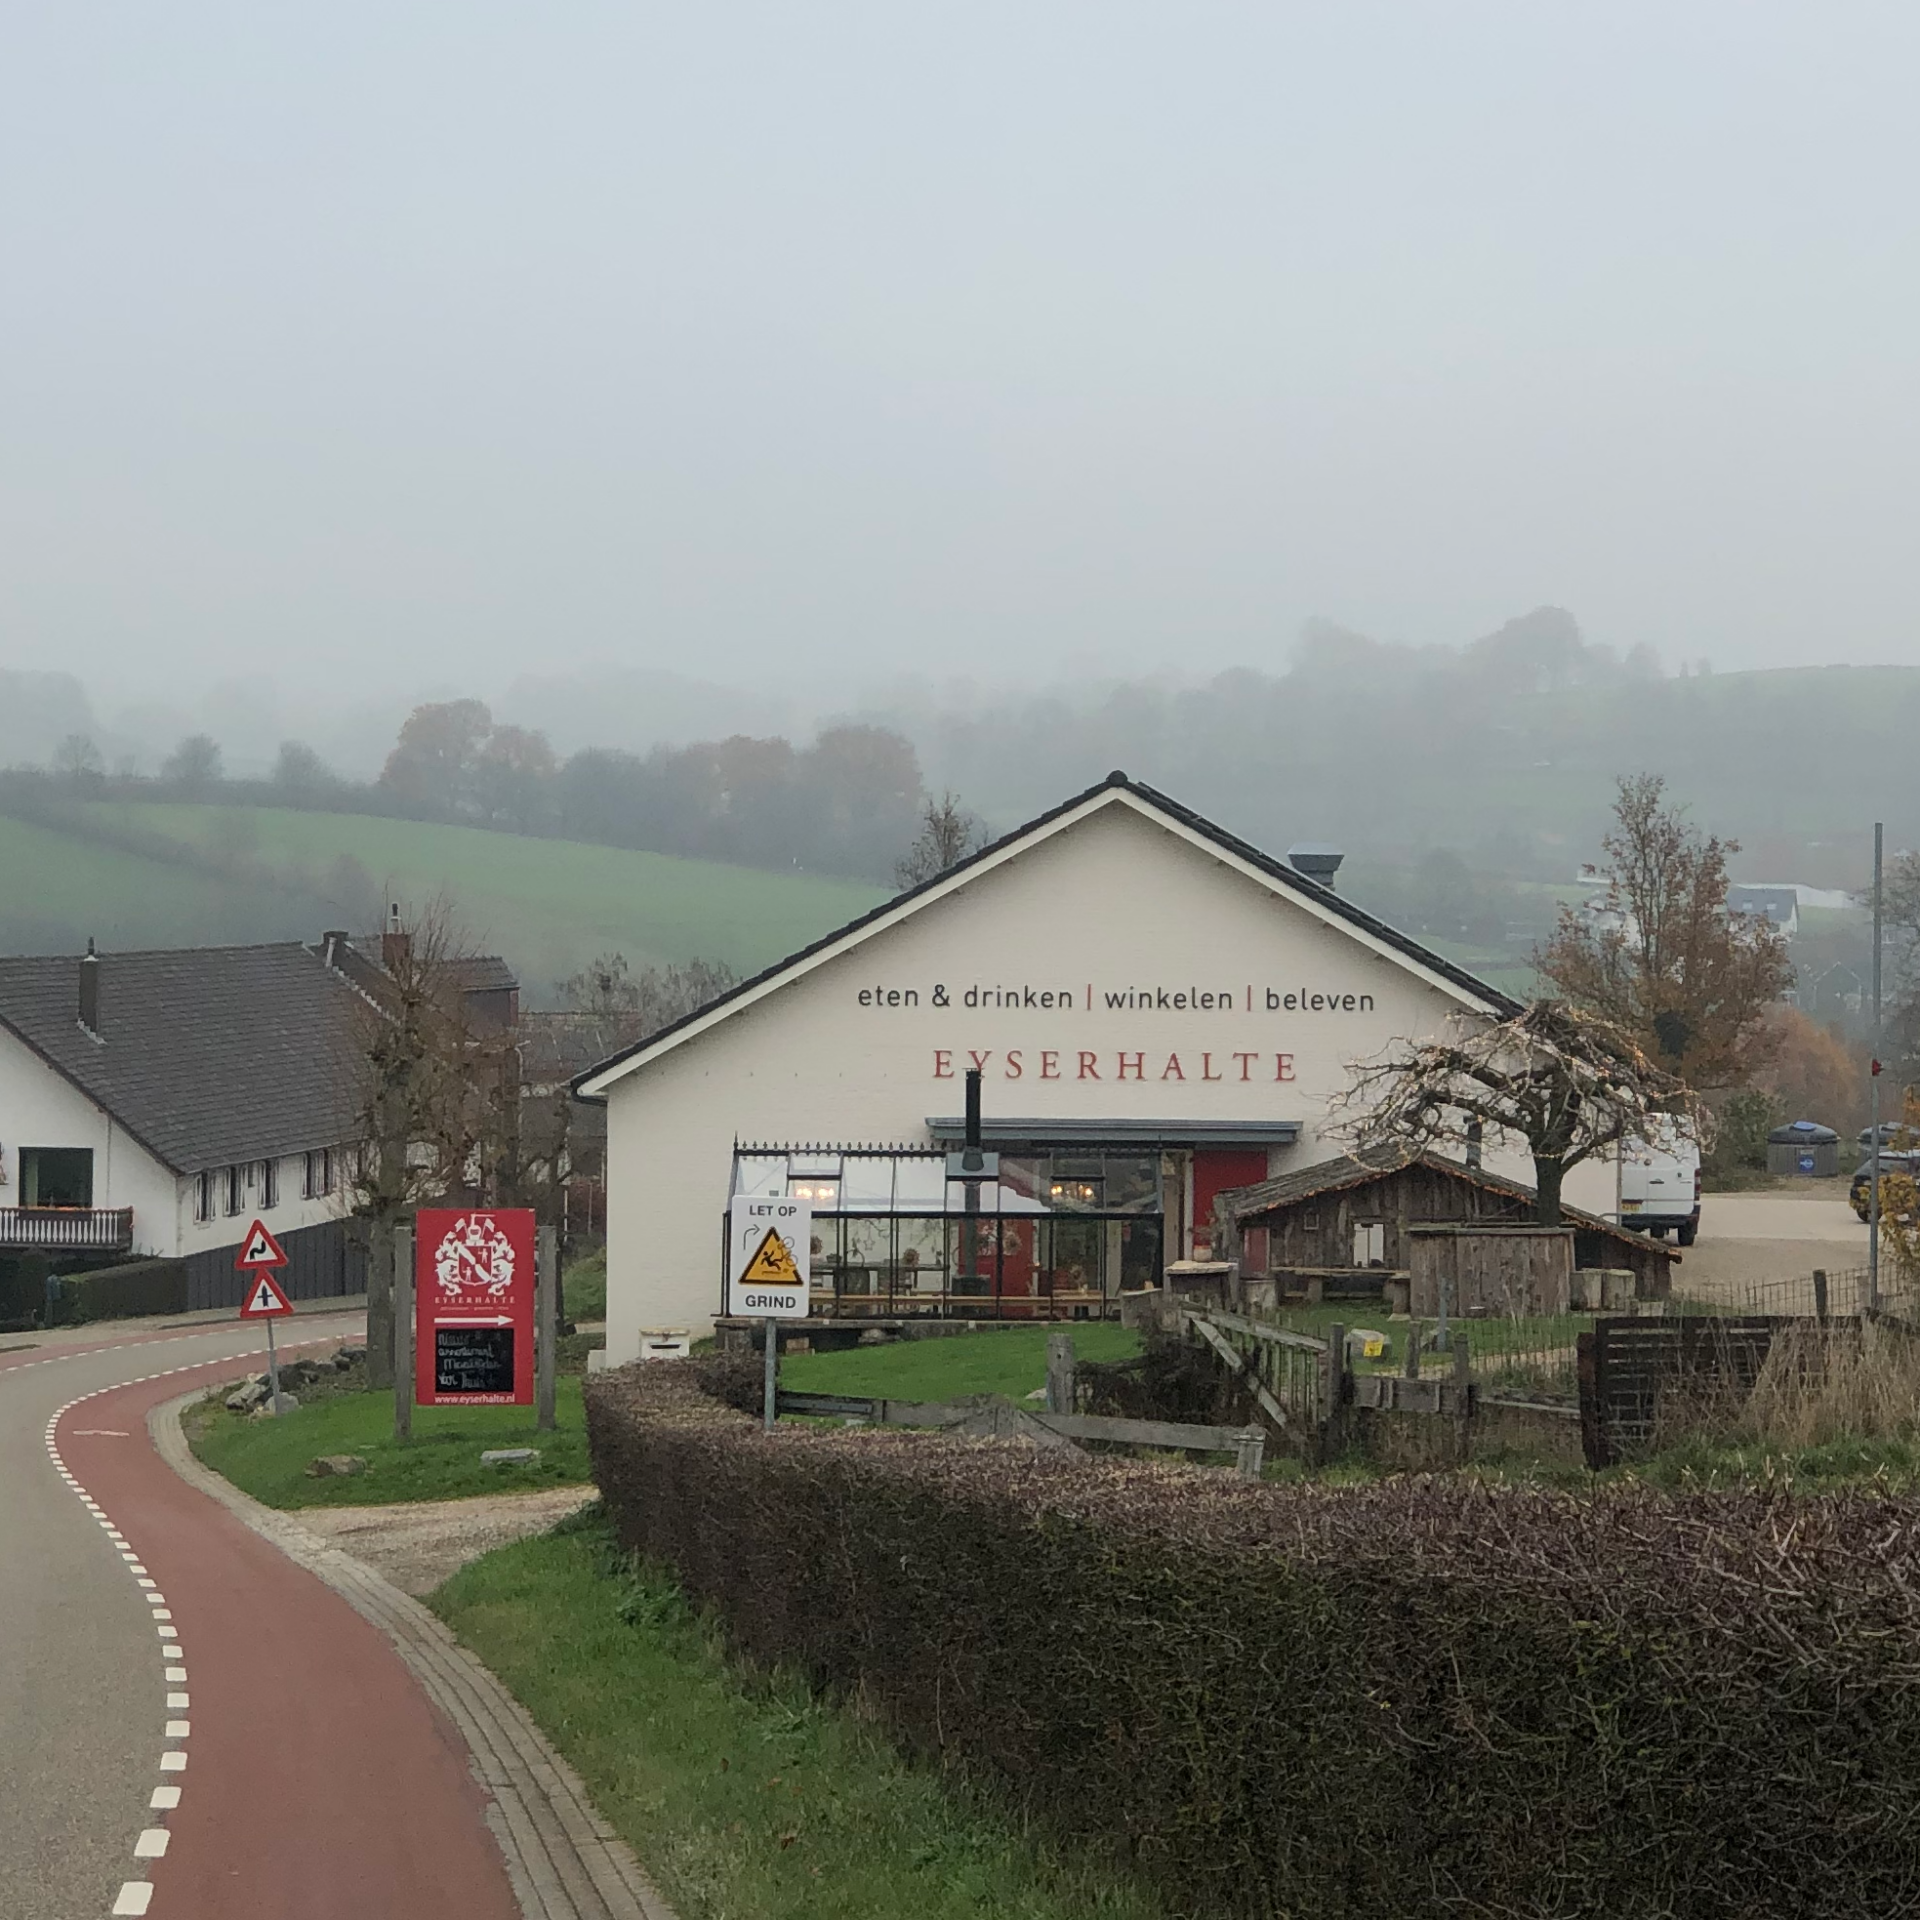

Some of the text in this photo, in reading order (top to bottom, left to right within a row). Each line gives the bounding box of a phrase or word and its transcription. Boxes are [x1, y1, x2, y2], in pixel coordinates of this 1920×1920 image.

[857, 985, 919, 1008] eten
[931, 983, 951, 1008] &
[963, 984, 1073, 1010] drinken
[1104, 985, 1233, 1011] winkelen
[1266, 986, 1375, 1012] beleven
[933, 1049, 1298, 1082] EYSERHALTE
[749, 1205, 797, 1217] LET OP
[434, 1296, 515, 1304] EYSERHALTE
[744, 1294, 797, 1309] GRIND
[434, 1393, 515, 1404] www.eyserhalte.nl
